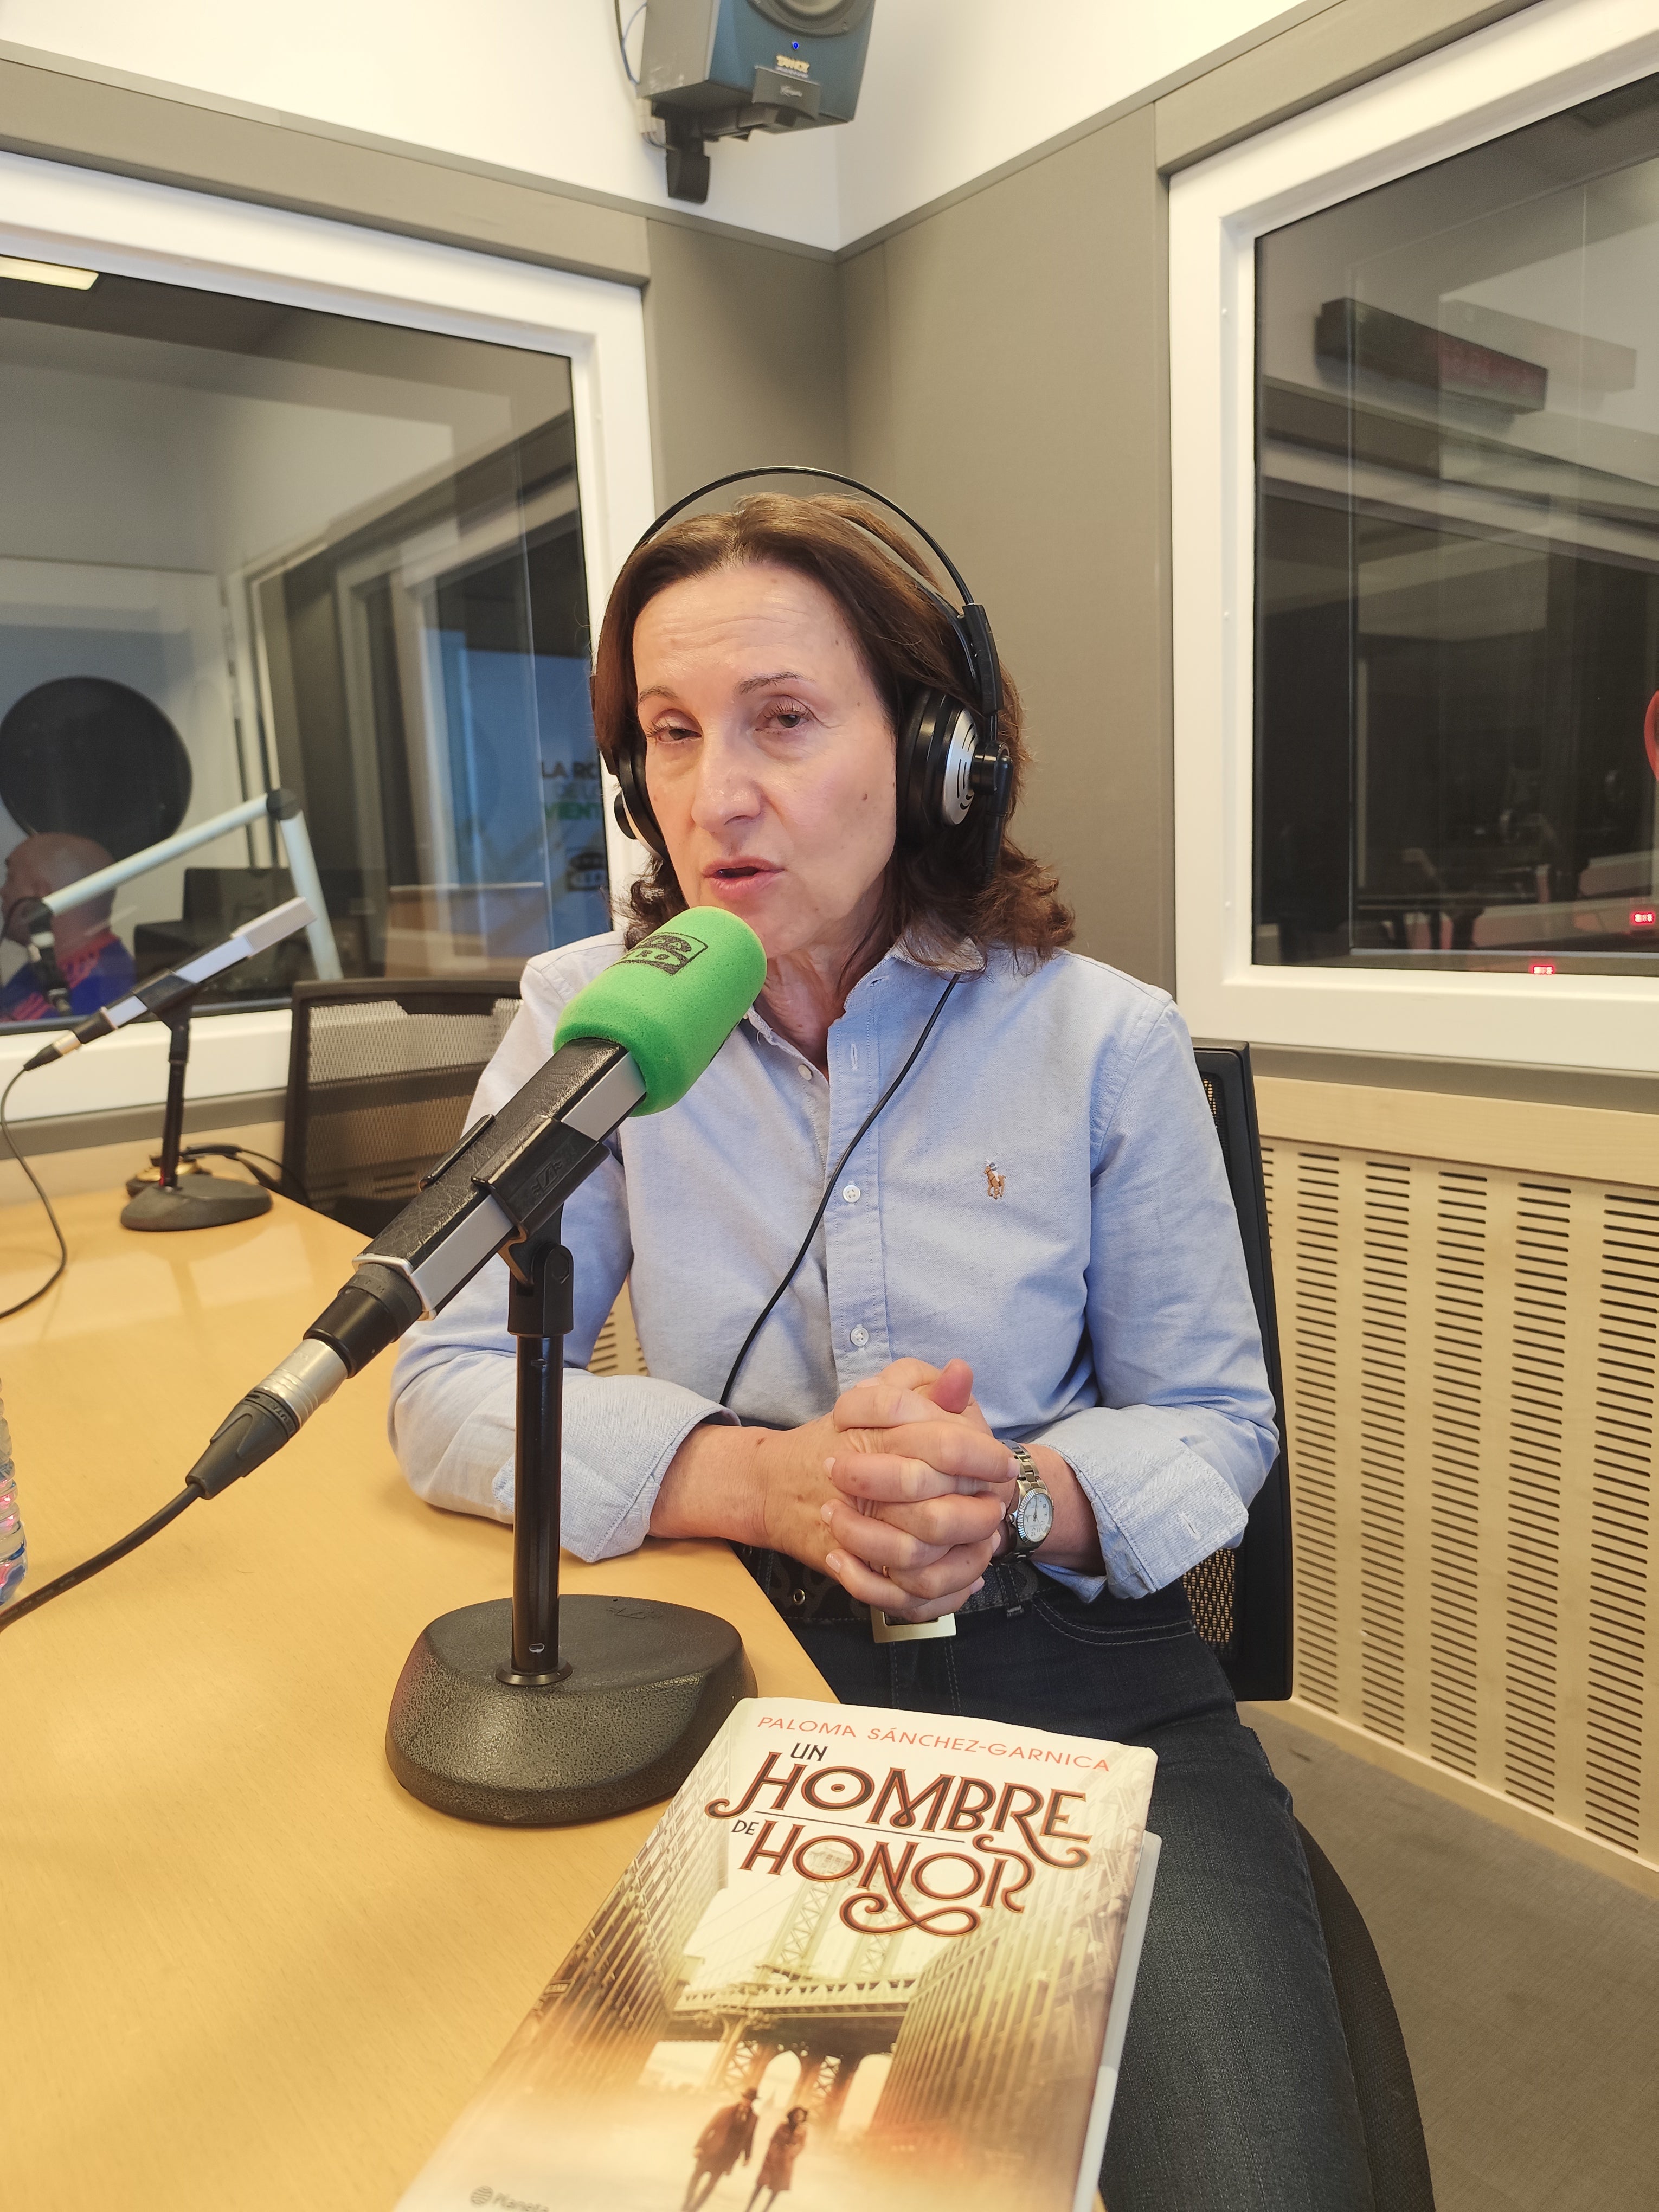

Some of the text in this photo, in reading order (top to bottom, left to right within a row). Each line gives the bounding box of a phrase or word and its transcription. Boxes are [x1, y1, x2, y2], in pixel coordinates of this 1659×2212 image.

[757, 1717, 1109, 1771] PALOMA SÁNCHEZ-GARNICA
[790, 1742, 829, 1761] UN
[705, 1751, 1092, 1870] HOMBRE
[731, 1819, 759, 1835] DE
[739, 1819, 1037, 1937] HONOR
